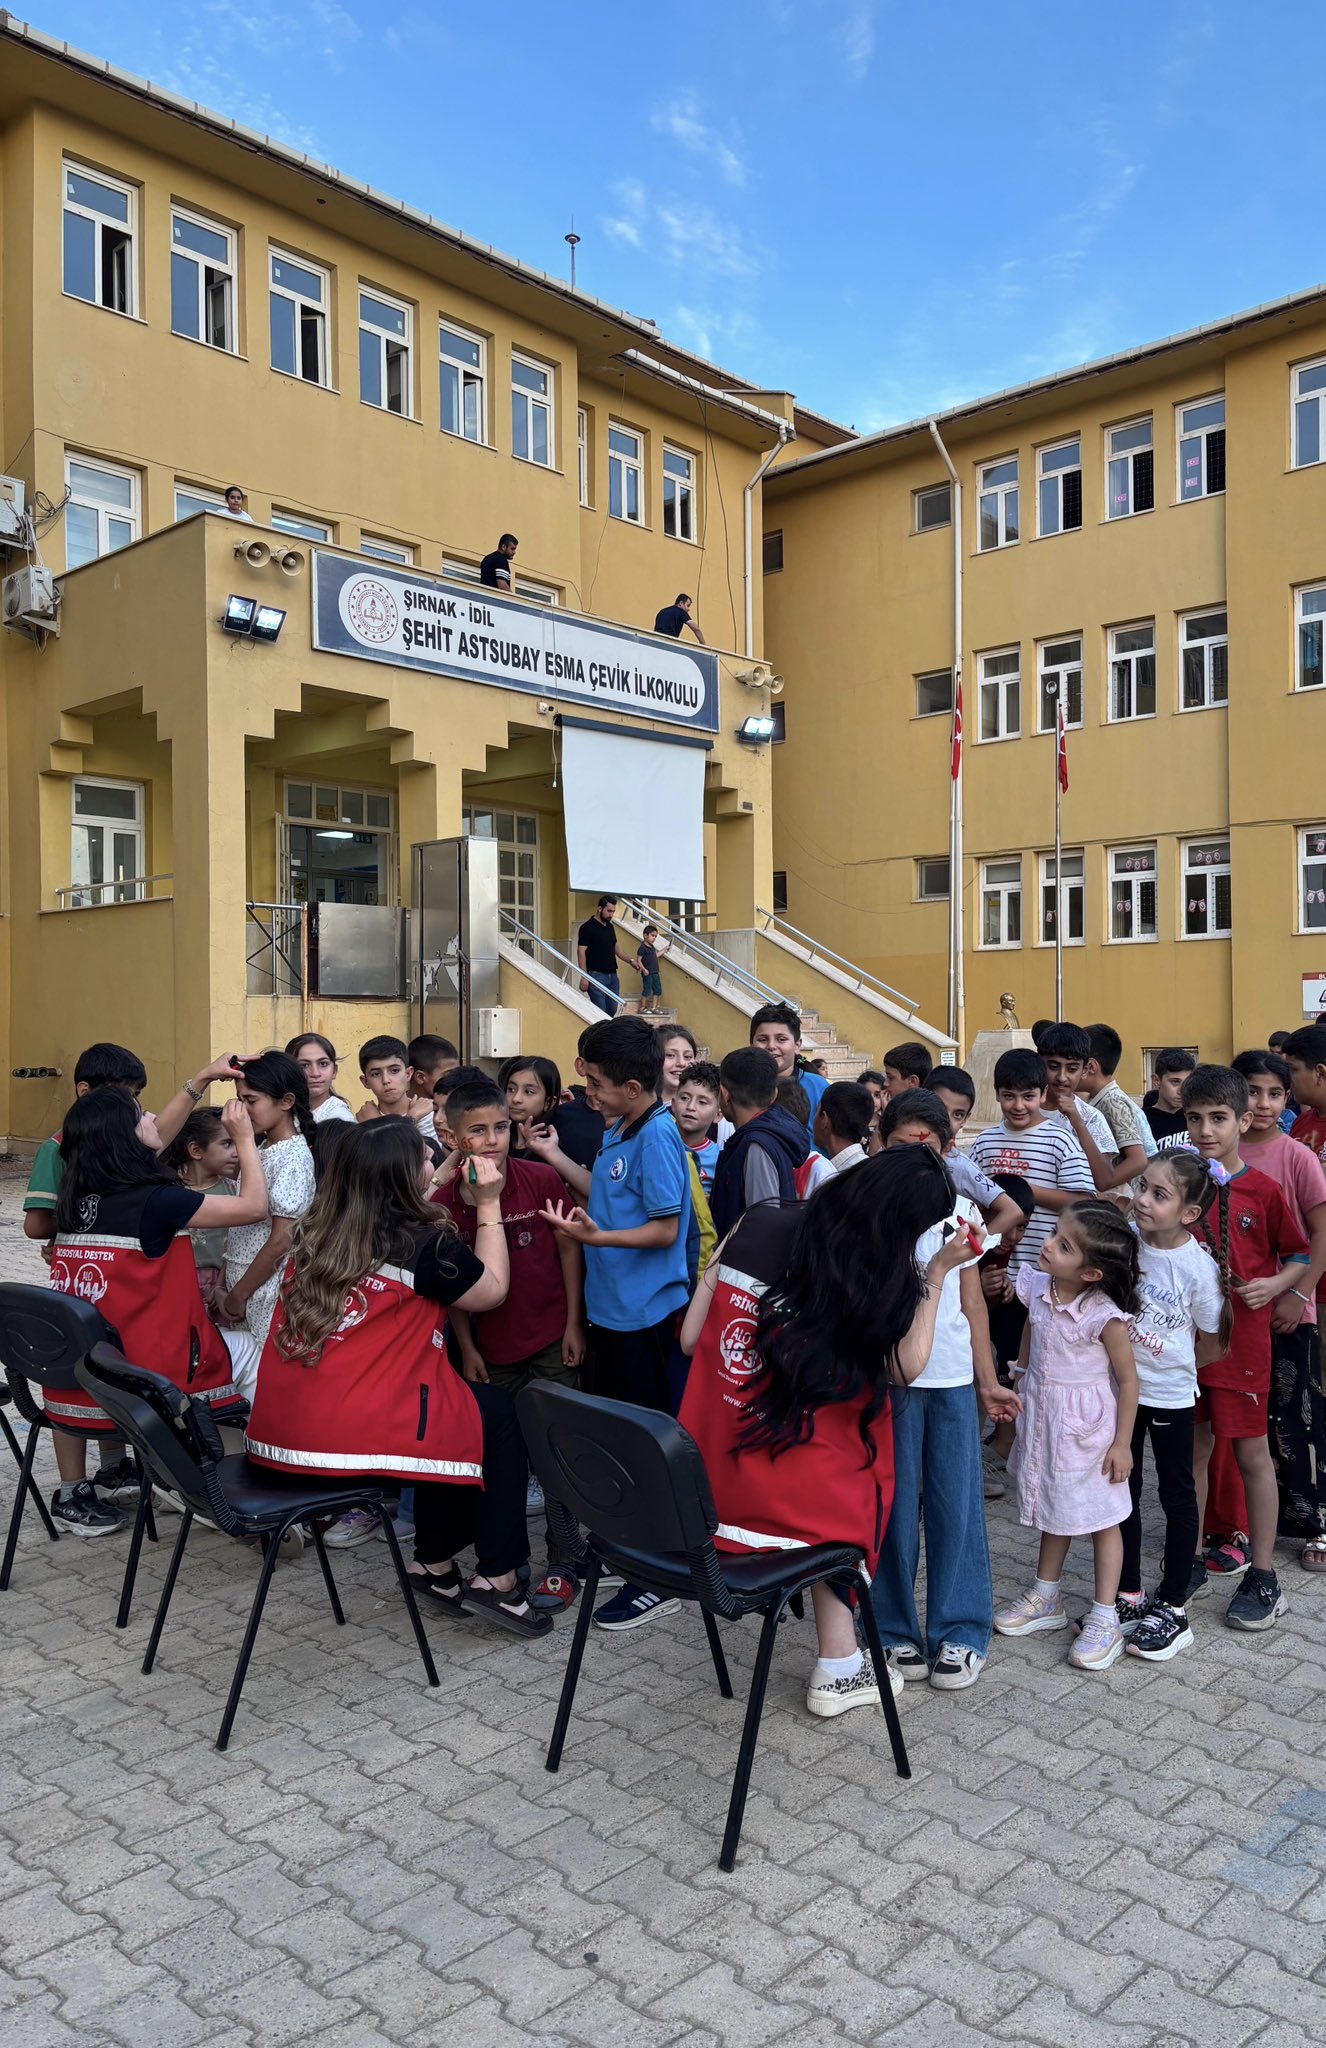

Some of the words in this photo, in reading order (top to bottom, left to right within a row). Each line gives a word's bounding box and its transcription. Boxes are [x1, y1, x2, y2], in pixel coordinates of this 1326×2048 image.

[404, 590, 457, 618] ŞIRNAK
[469, 602, 495, 628] İDİL
[402, 618, 453, 651] ŞEHİT
[458, 631, 540, 673] ASTSUBAY
[545, 651, 585, 683] ESMA
[589, 662, 631, 692] ÇEVİK
[634, 667, 698, 709] İLKOKULU
[1157, 1131, 1192, 1151] TRIKE
[84, 1250, 115, 1261] DESTEK
[79, 1282, 99, 1297] 144
[359, 1276, 388, 1292] TEK
[729, 1293, 760, 1316] PSİKO
[731, 1327, 752, 1345] ALO
[1128, 1324, 1164, 1357] ivity
[724, 1338, 759, 1368] 183
